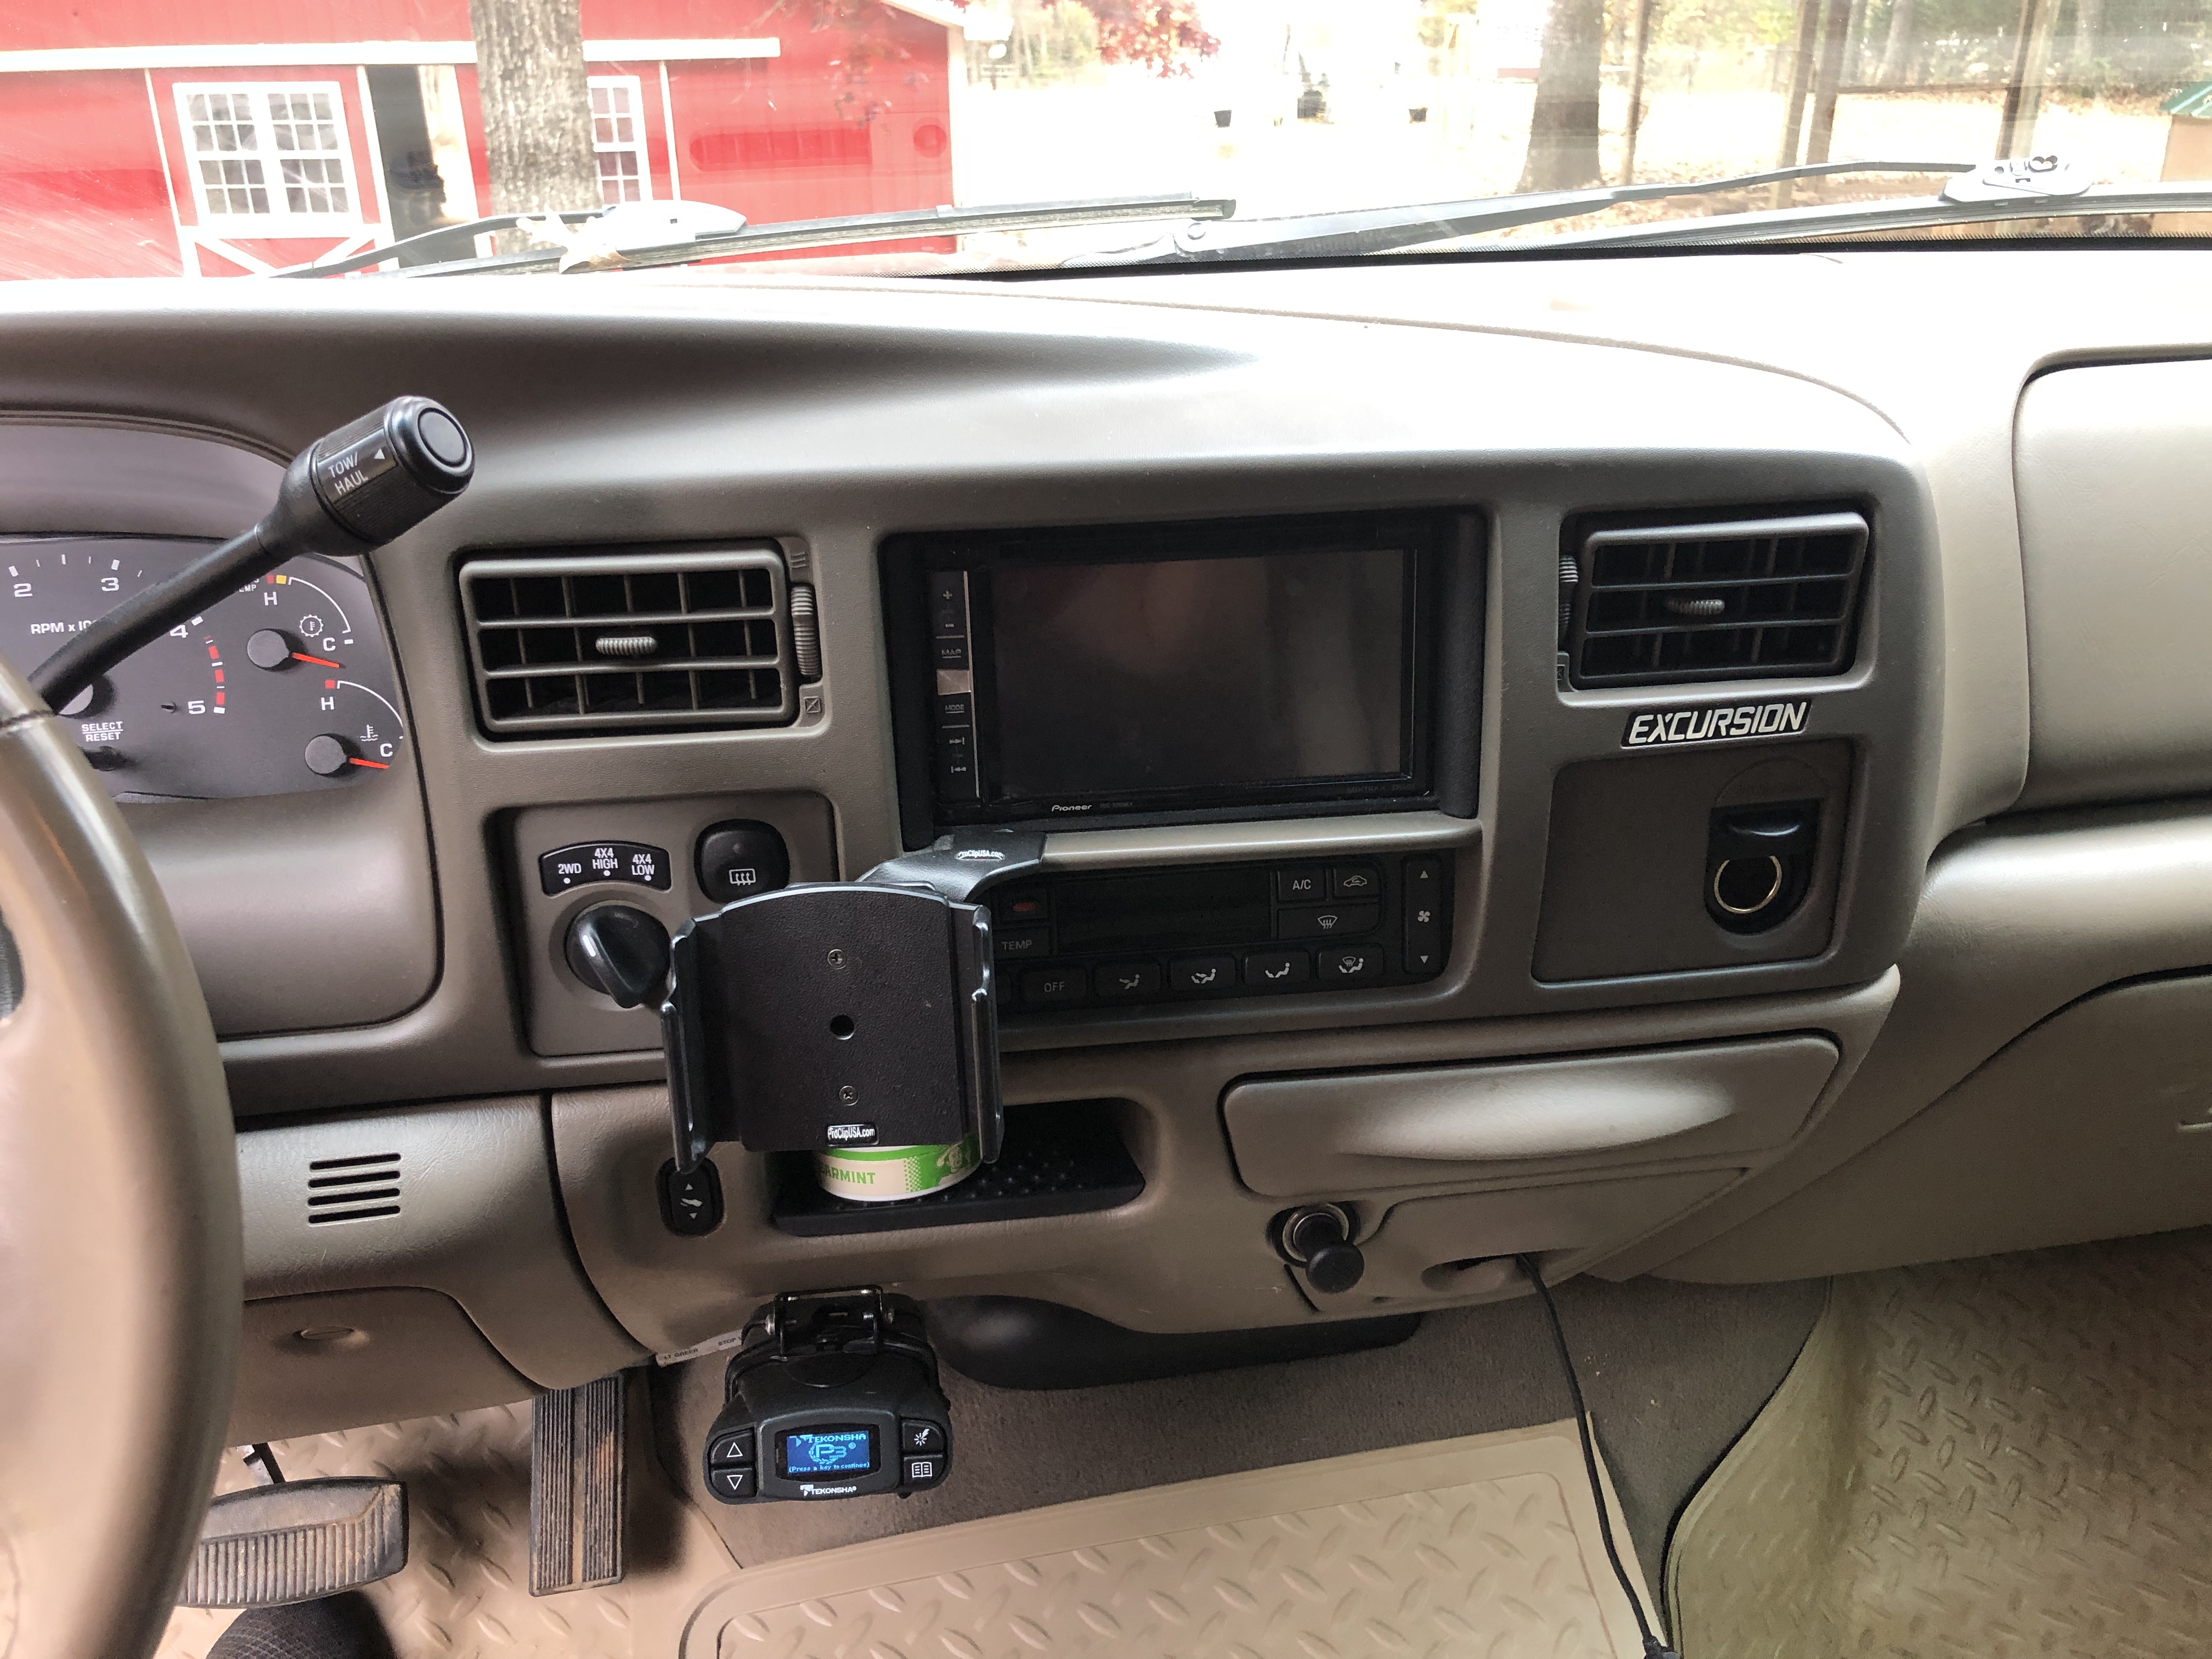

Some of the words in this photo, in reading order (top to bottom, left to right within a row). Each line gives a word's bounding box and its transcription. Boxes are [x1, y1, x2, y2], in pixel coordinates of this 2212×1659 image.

[328, 452, 358, 478] TOW/
[334, 470, 369, 495] HAUL
[14, 583, 32, 597] 2
[101, 577, 119, 591] 3
[239, 584, 257, 592] MP
[264, 591, 278, 606] H
[31, 622, 64, 634] RPM
[170, 624, 188, 638] 4
[323, 637, 336, 651] C
[188, 700, 206, 714] 5
[321, 696, 335, 710] H
[82, 721, 123, 732] SELECT
[1628, 702, 1807, 744] EXCURSION
[86, 732, 121, 742] RESET
[380, 743, 393, 757] C
[594, 848, 614, 859] 4X4
[632, 854, 652, 865] 4X4
[558, 863, 582, 874] 2WD
[592, 858, 619, 870] HIGH
[631, 864, 655, 876] LOW
[1292, 879, 1312, 890] A/C
[1001, 939, 1032, 951] TEMP
[1044, 981, 1065, 992] OFF
[827, 1126, 876, 1141] ProClipUSA.com
[718, 1337, 737, 1346] STOP
[808, 1433, 866, 1443] TEKONSHA
[811, 1487, 853, 1495] TEKONSHA
